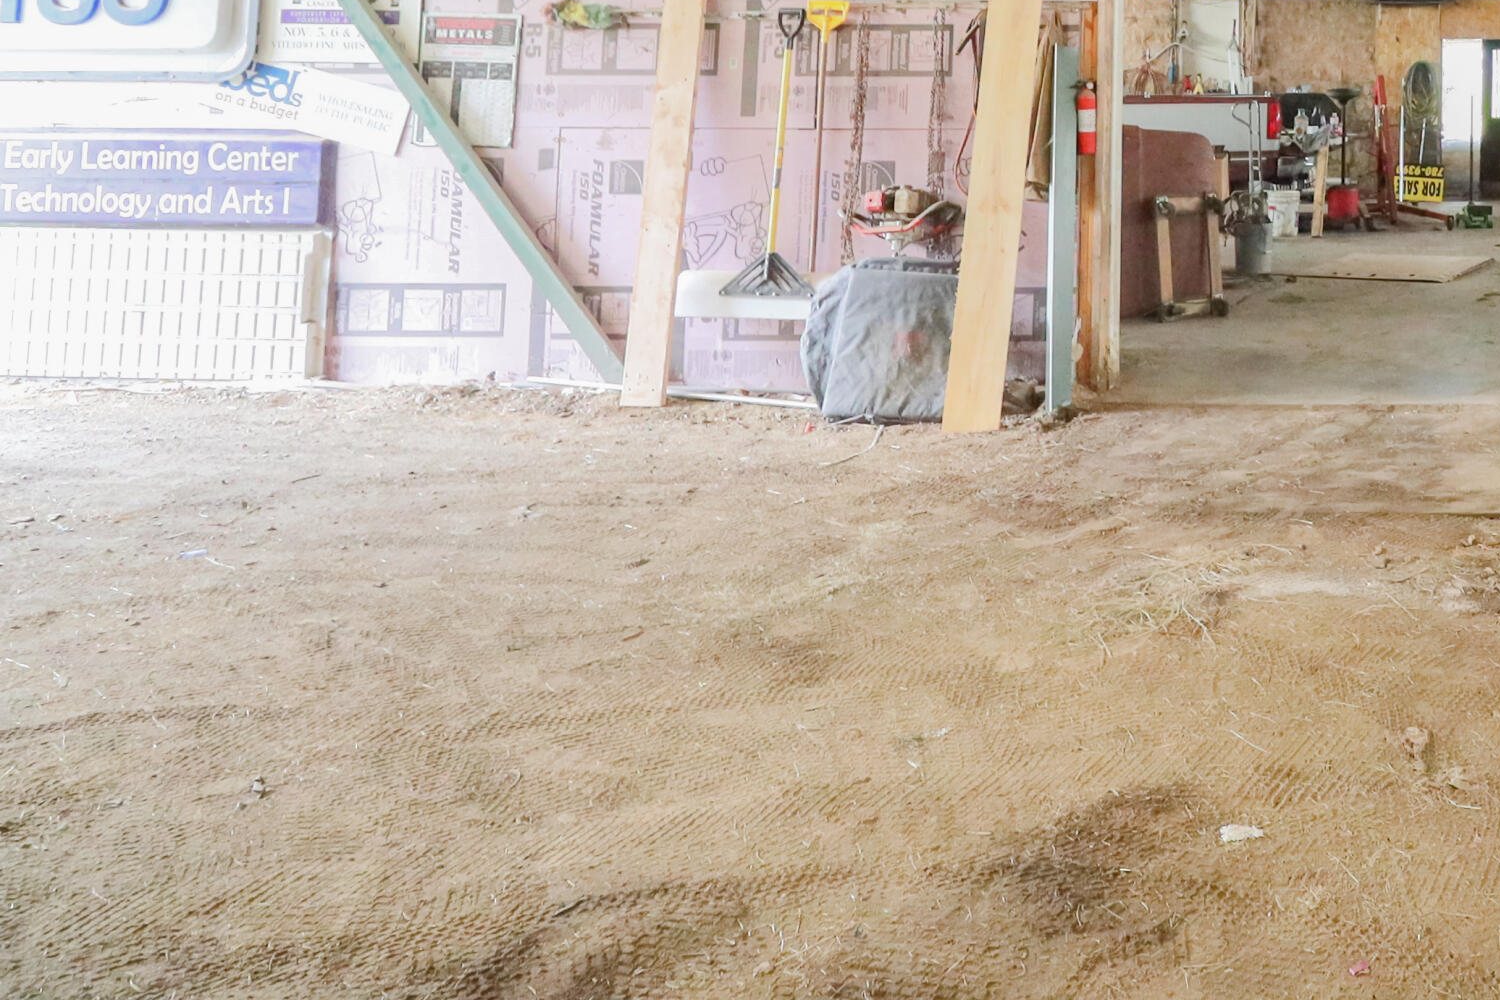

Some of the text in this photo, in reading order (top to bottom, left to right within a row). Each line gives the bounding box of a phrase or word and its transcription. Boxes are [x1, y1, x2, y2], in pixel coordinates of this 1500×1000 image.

[435, 28, 493, 39] METALS
[215, 92, 233, 103] on
[250, 99, 299, 120] budget
[4, 141, 300, 175] Early Learning Center
[0, 183, 152, 219] Technology
[159, 186, 213, 215] and
[219, 186, 274, 215] Arts
[1422, 180, 1441, 197] FOR
